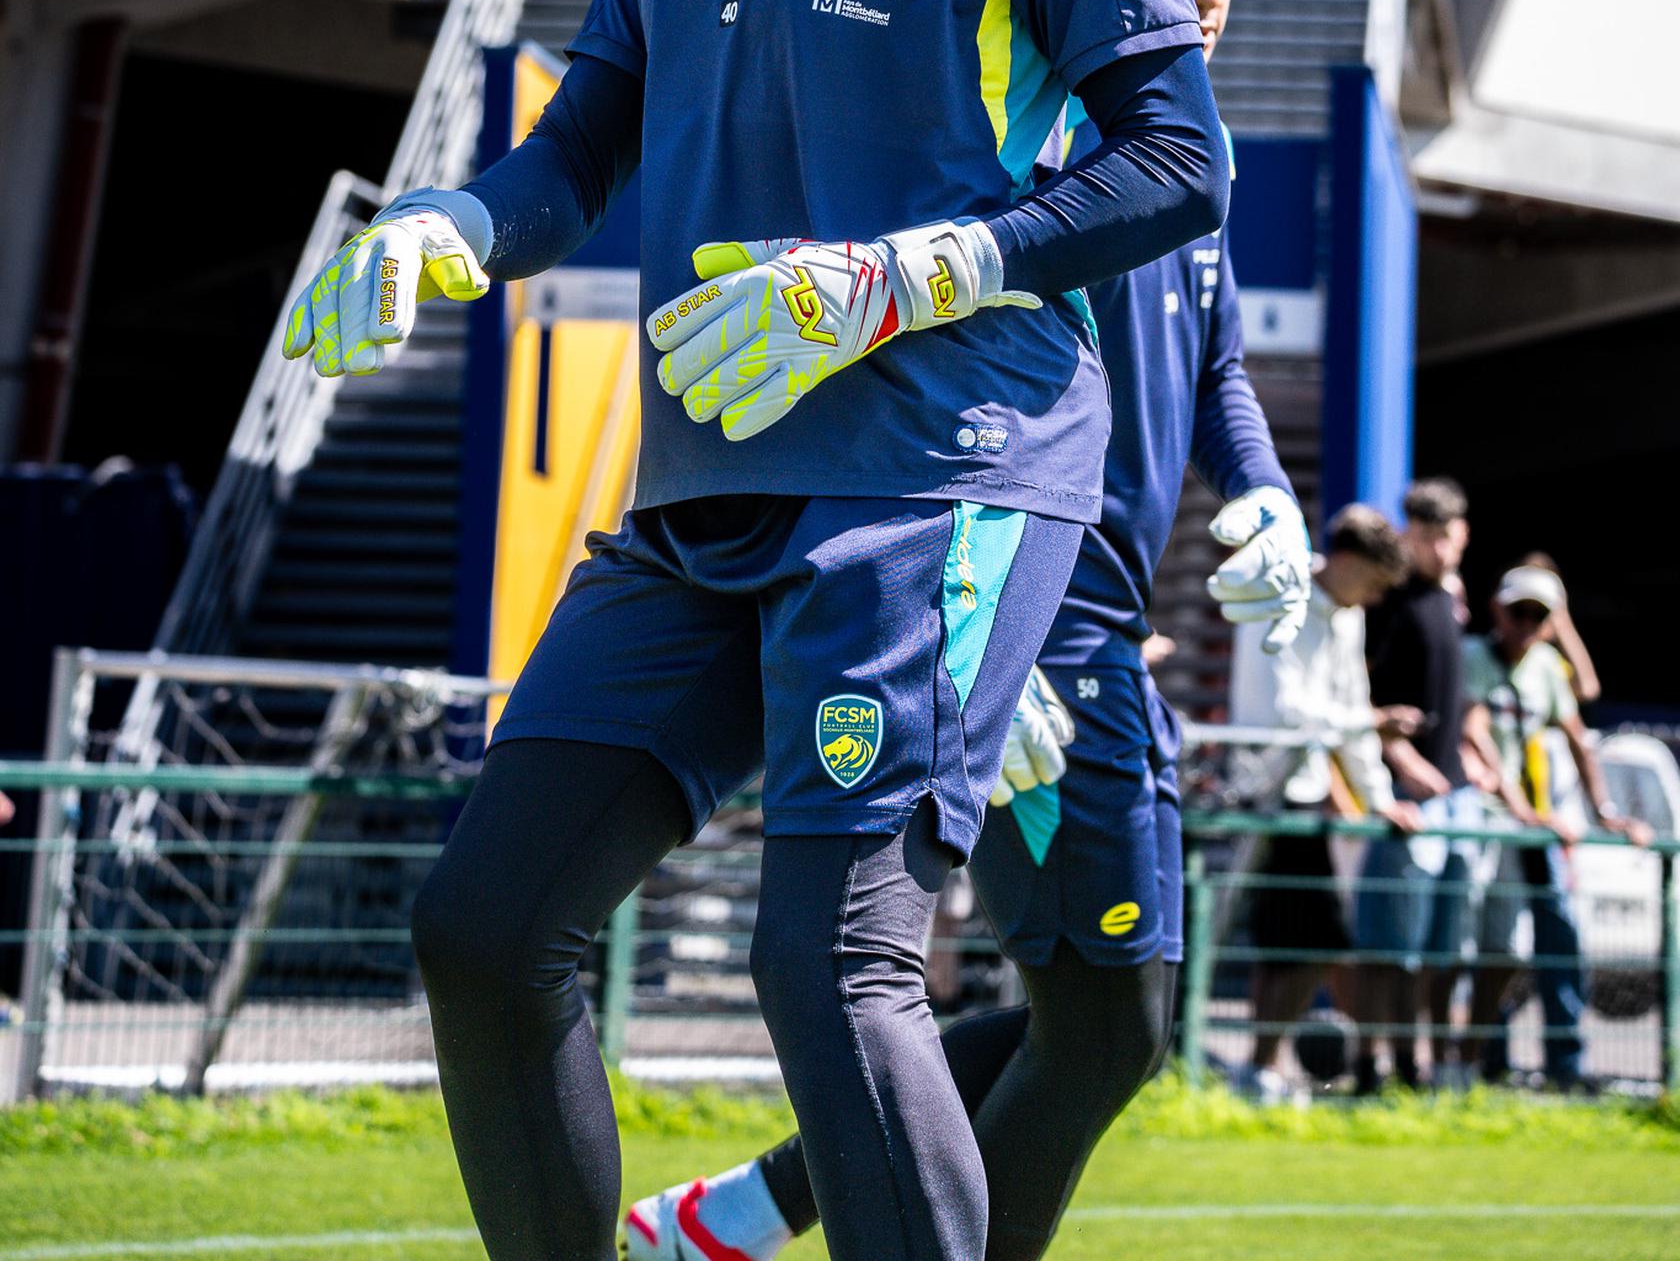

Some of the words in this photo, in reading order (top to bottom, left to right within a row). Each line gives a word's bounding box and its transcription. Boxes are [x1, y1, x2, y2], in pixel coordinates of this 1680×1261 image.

[721, 1, 738, 23] 40
[381, 257, 399, 279] AB
[379, 281, 396, 325] STAR
[655, 310, 677, 337] AB
[677, 284, 723, 318] STAR
[1077, 677, 1100, 699] 50
[823, 706, 876, 724] FCSM
